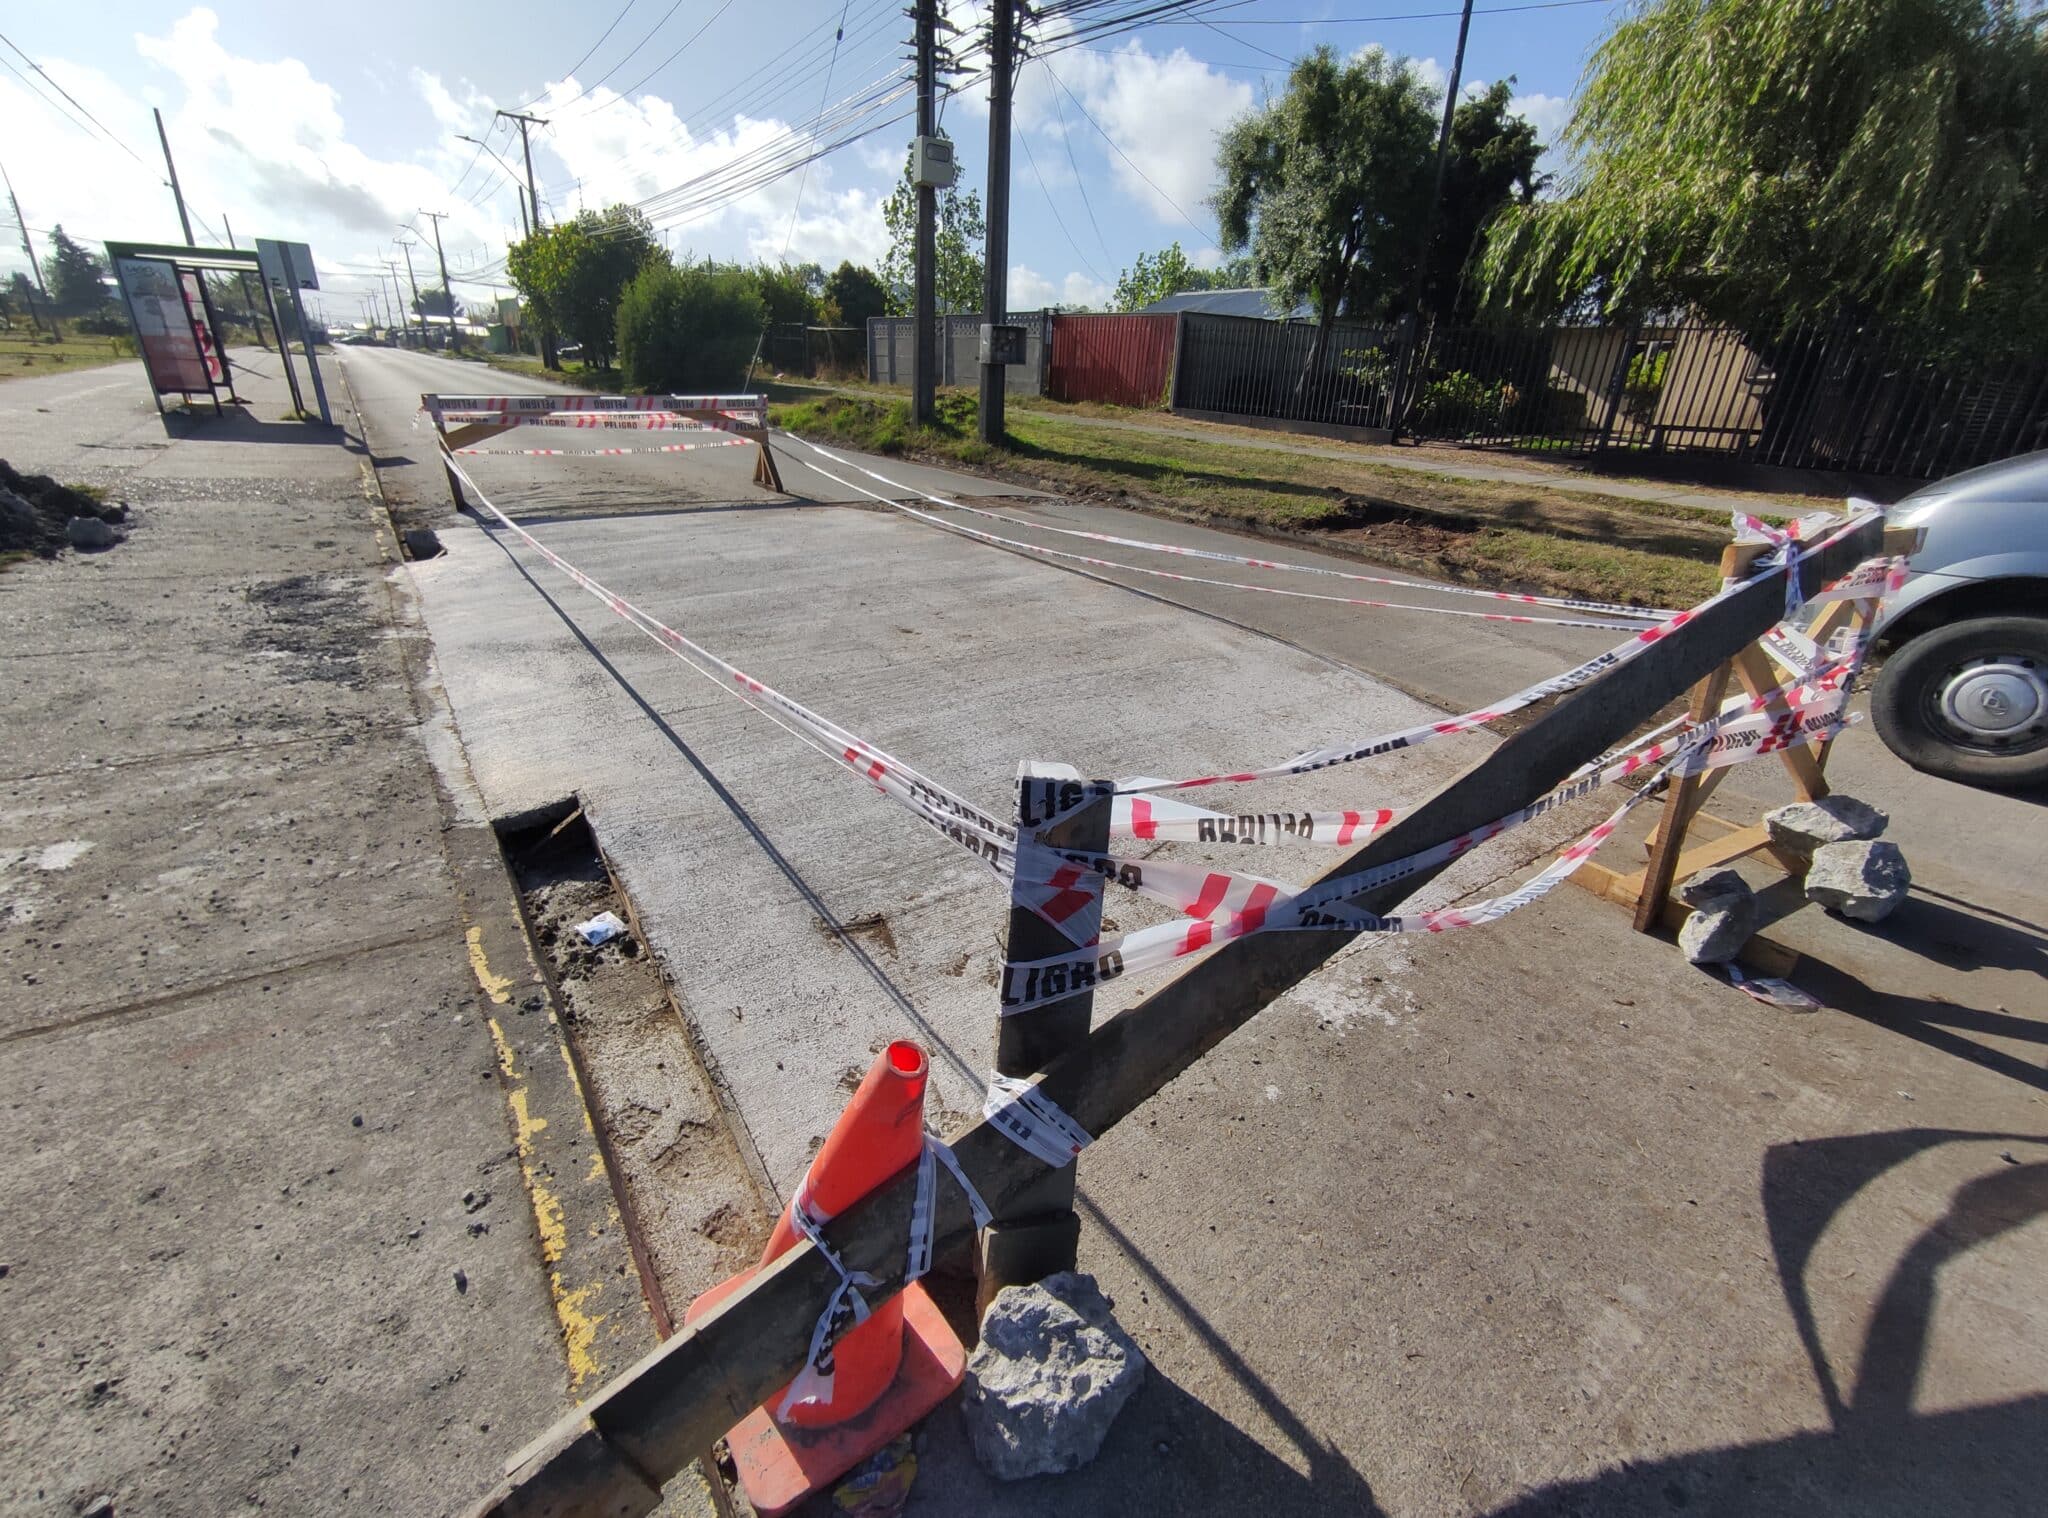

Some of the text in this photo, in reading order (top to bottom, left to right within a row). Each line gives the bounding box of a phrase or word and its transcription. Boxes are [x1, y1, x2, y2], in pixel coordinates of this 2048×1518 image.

[519, 400, 556, 410] PELIGRO
[594, 400, 628, 410] PELIGRO
[529, 418, 566, 427] PELIGRO
[604, 421, 638, 430] PELIGRO
[672, 422, 703, 431] PELIGRO
[1001, 949, 1126, 1007] LIGRO
